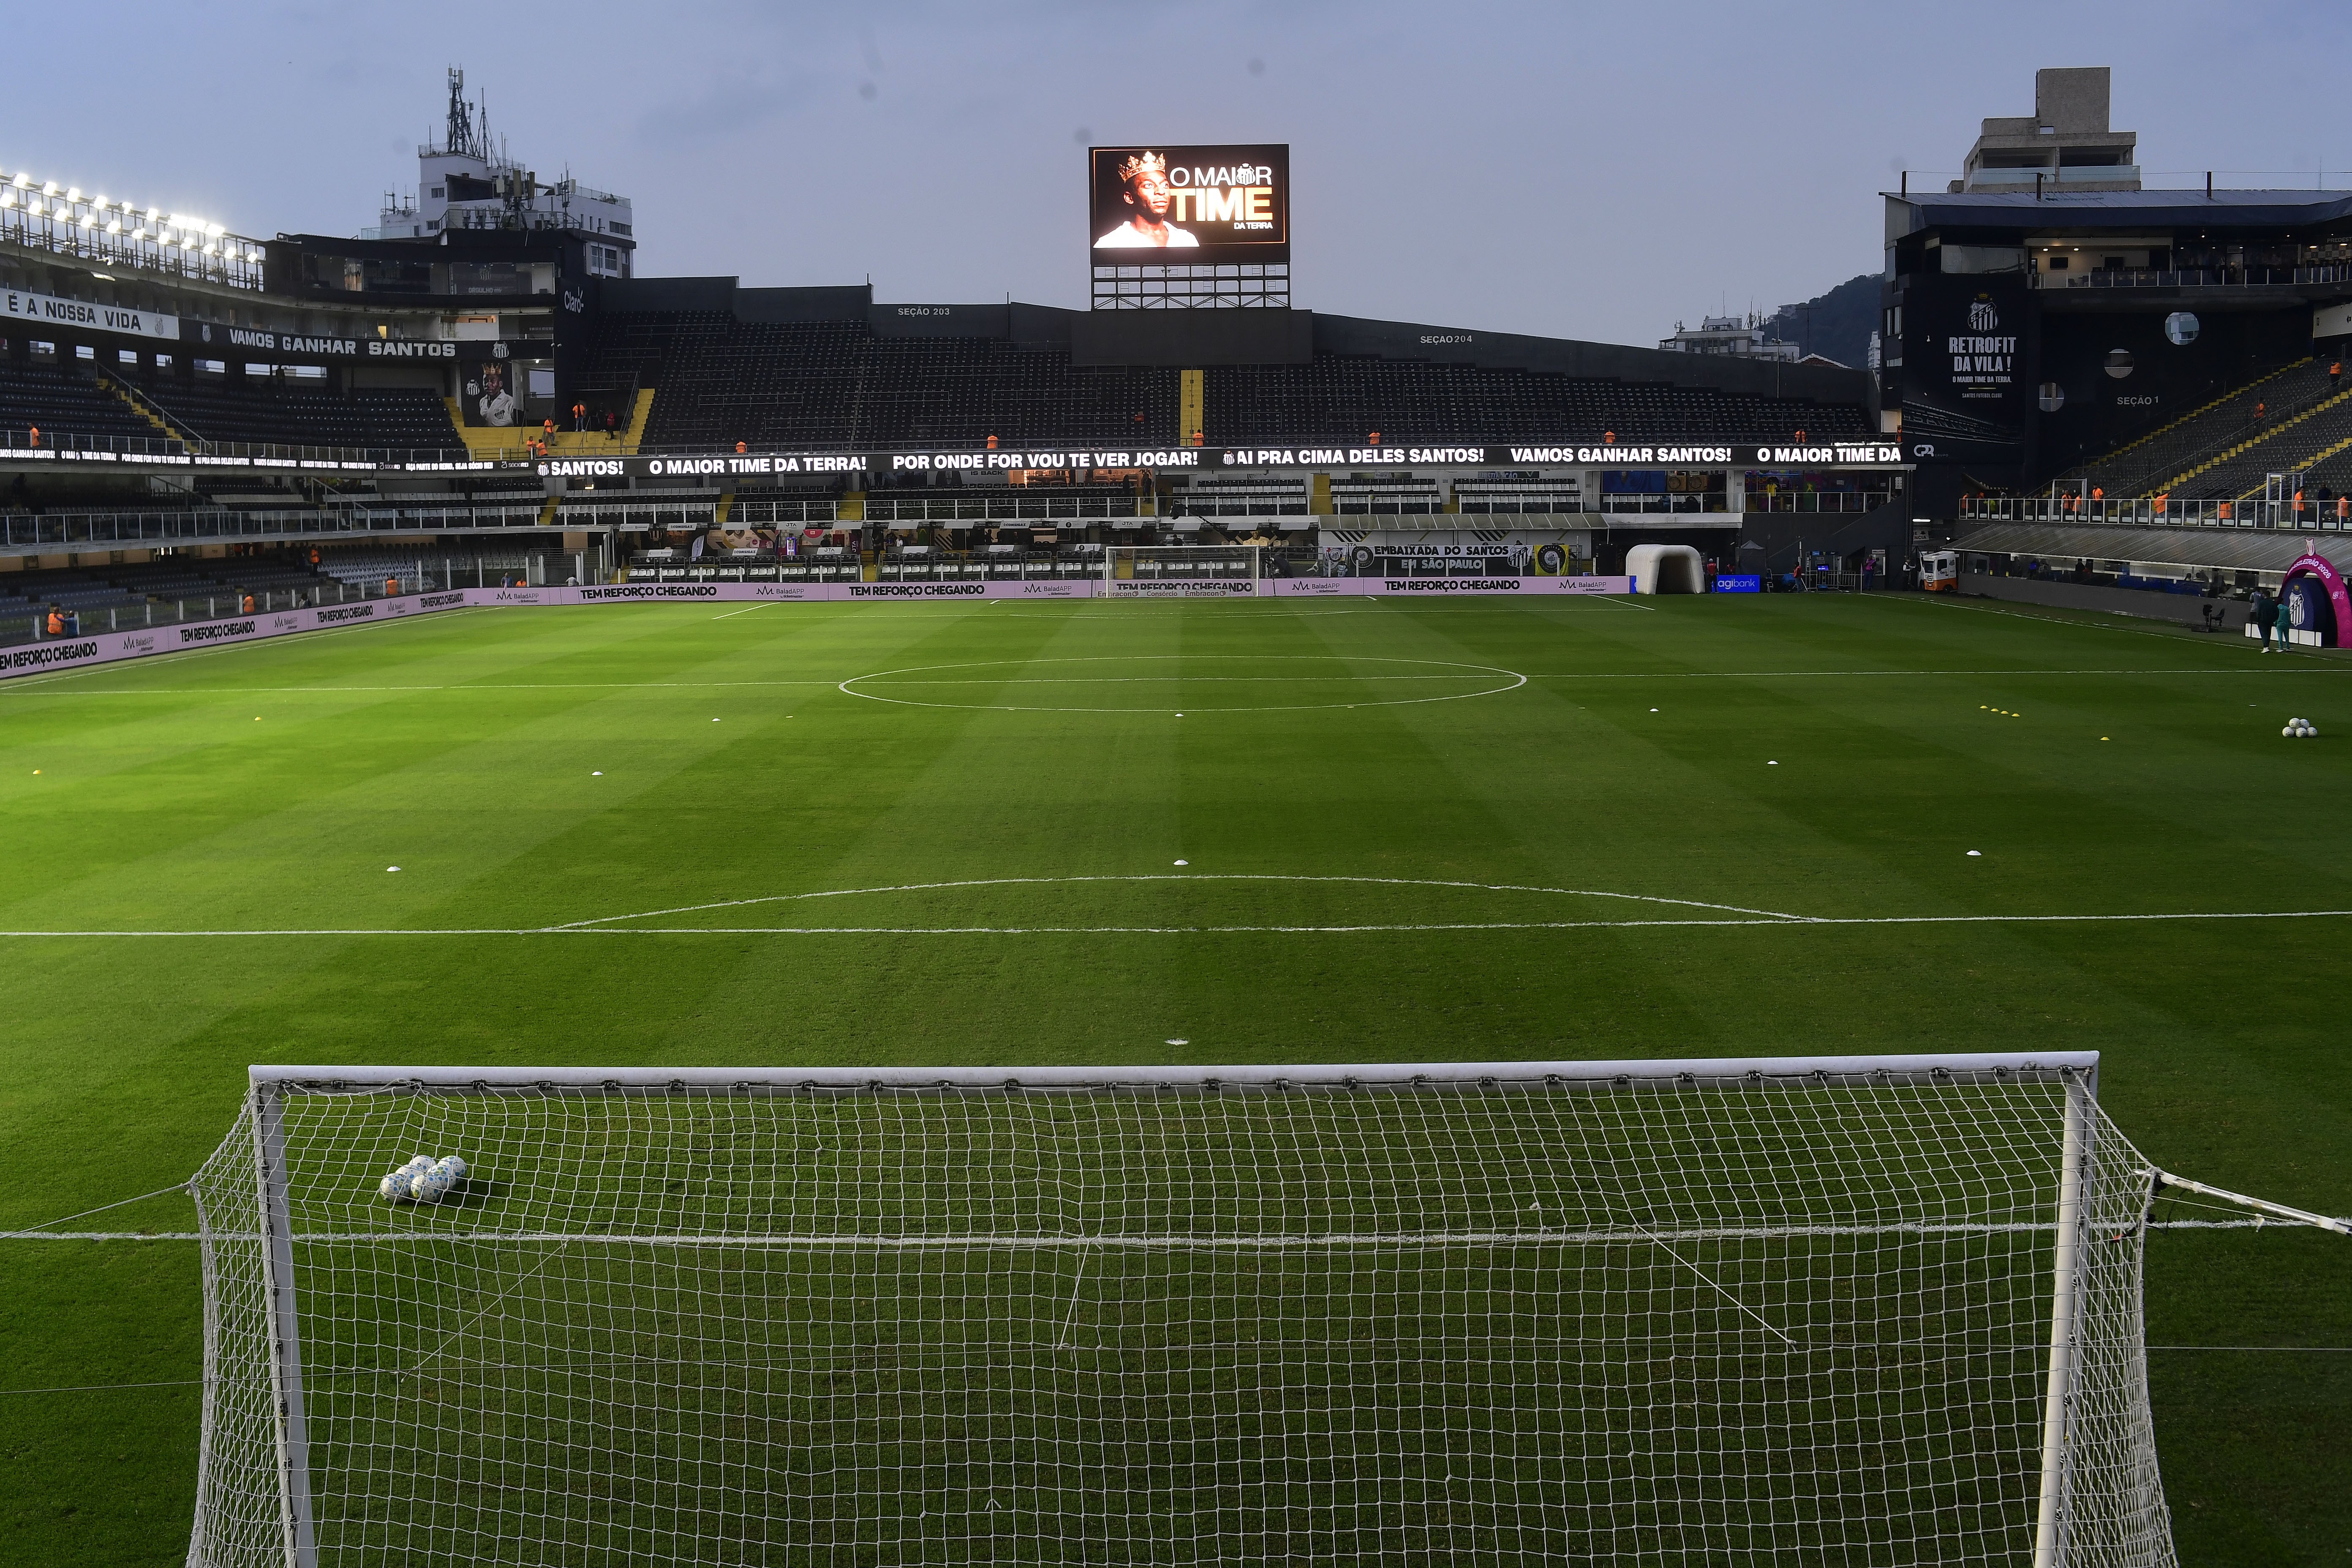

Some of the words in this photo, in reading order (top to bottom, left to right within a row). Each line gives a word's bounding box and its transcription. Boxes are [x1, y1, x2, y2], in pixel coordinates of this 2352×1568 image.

[1170, 167, 1190, 187] O
[1170, 187, 1273, 221] TIME
[564, 289, 583, 313] Claro
[8, 292, 18, 312] É
[27, 298, 38, 315] A
[45, 301, 96, 324] NOSSA
[105, 310, 142, 331] VIDA
[898, 306, 930, 318] SEÇÃO
[229, 329, 274, 348] VAMOS
[283, 336, 356, 354] GANHAR
[368, 342, 455, 357] SANTOS
[1420, 334, 1453, 345] SEÇÃO
[1949, 337, 2017, 353] RETROFIT
[1954, 357, 1971, 371] DA
[1974, 357, 2003, 371] VILA
[2117, 395, 2152, 406] SEÇÃO
[12, 449, 33, 458] GANHAR
[34, 450, 55, 459] SANTOS!
[61, 450, 65, 459] O
[82, 451, 93, 460] TIME
[93, 452, 100, 460] DA
[100, 452, 116, 461] TERRA!
[131, 454, 143, 463] ONDE
[144, 455, 152, 463] FOR
[152, 455, 161, 463] VOU
[162, 456, 166, 464] TE
[893, 456, 930, 469] POR
[934, 455, 983, 469] ONDE
[988, 454, 1022, 468] FOR
[1027, 454, 1065, 468] VOU
[1069, 454, 1090, 467] TE
[1094, 453, 1129, 466] VER
[1134, 452, 1198, 466] JOGAR!
[1258, 450, 1294, 464] PRA
[1299, 450, 1345, 463] CIMA
[1350, 449, 1405, 463] DELES
[1409, 448, 1484, 463] SANTOS!
[1511, 448, 1573, 462] VAMOS
[1578, 448, 1652, 462] GANHAR
[1657, 448, 1731, 462] SANTOS!
[1757, 448, 1770, 462] O
[1775, 448, 1832, 462] MAIOR
[1836, 448, 1875, 461] TIME
[1879, 448, 1901, 461] DA
[468, 461, 483, 469] SÓCIO
[551, 461, 623, 475] SANTOS!
[649, 460, 662, 474] O
[667, 460, 725, 474] MAIOR
[729, 458, 770, 473] TIME
[775, 458, 799, 471] DA
[803, 457, 866, 471] TERRA!
[1375, 545, 1442, 555] EMBAIXADA
[1444, 545, 1461, 555] DO
[1466, 546, 1508, 555] SANTOS
[1421, 558, 1444, 569] SÃO
[1449, 560, 1482, 569] PAULO
[2317, 564, 2332, 579] 2026
[849, 586, 871, 596] TEM
[872, 585, 923, 598] REFORÇO
[924, 584, 985, 595] CHEGANDO
[1192, 583, 1252, 592] CHEGANDO
[1385, 581, 1407, 591] TEM
[1408, 580, 1458, 592] REFORÇO
[1460, 580, 1520, 590] CHEGANDO
[1718, 578, 1755, 590] agibank
[580, 589, 602, 599] TEM
[604, 587, 654, 599] REFORÇO
[656, 586, 717, 596] CHEGANDO
[420, 597, 429, 608] TEM
[429, 594, 445, 608] REFORÇO
[445, 592, 464, 604] CHEGANDO
[317, 611, 327, 623] TEM
[327, 607, 348, 623] REFORÇO
[349, 604, 373, 618] CHEGANDO
[180, 628, 194, 642] TEM
[195, 624, 223, 641] REFORÇO
[223, 620, 255, 637] CHEGANDO
[14, 648, 52, 667] REFORÇO
[53, 642, 97, 662] CHEGANDO
